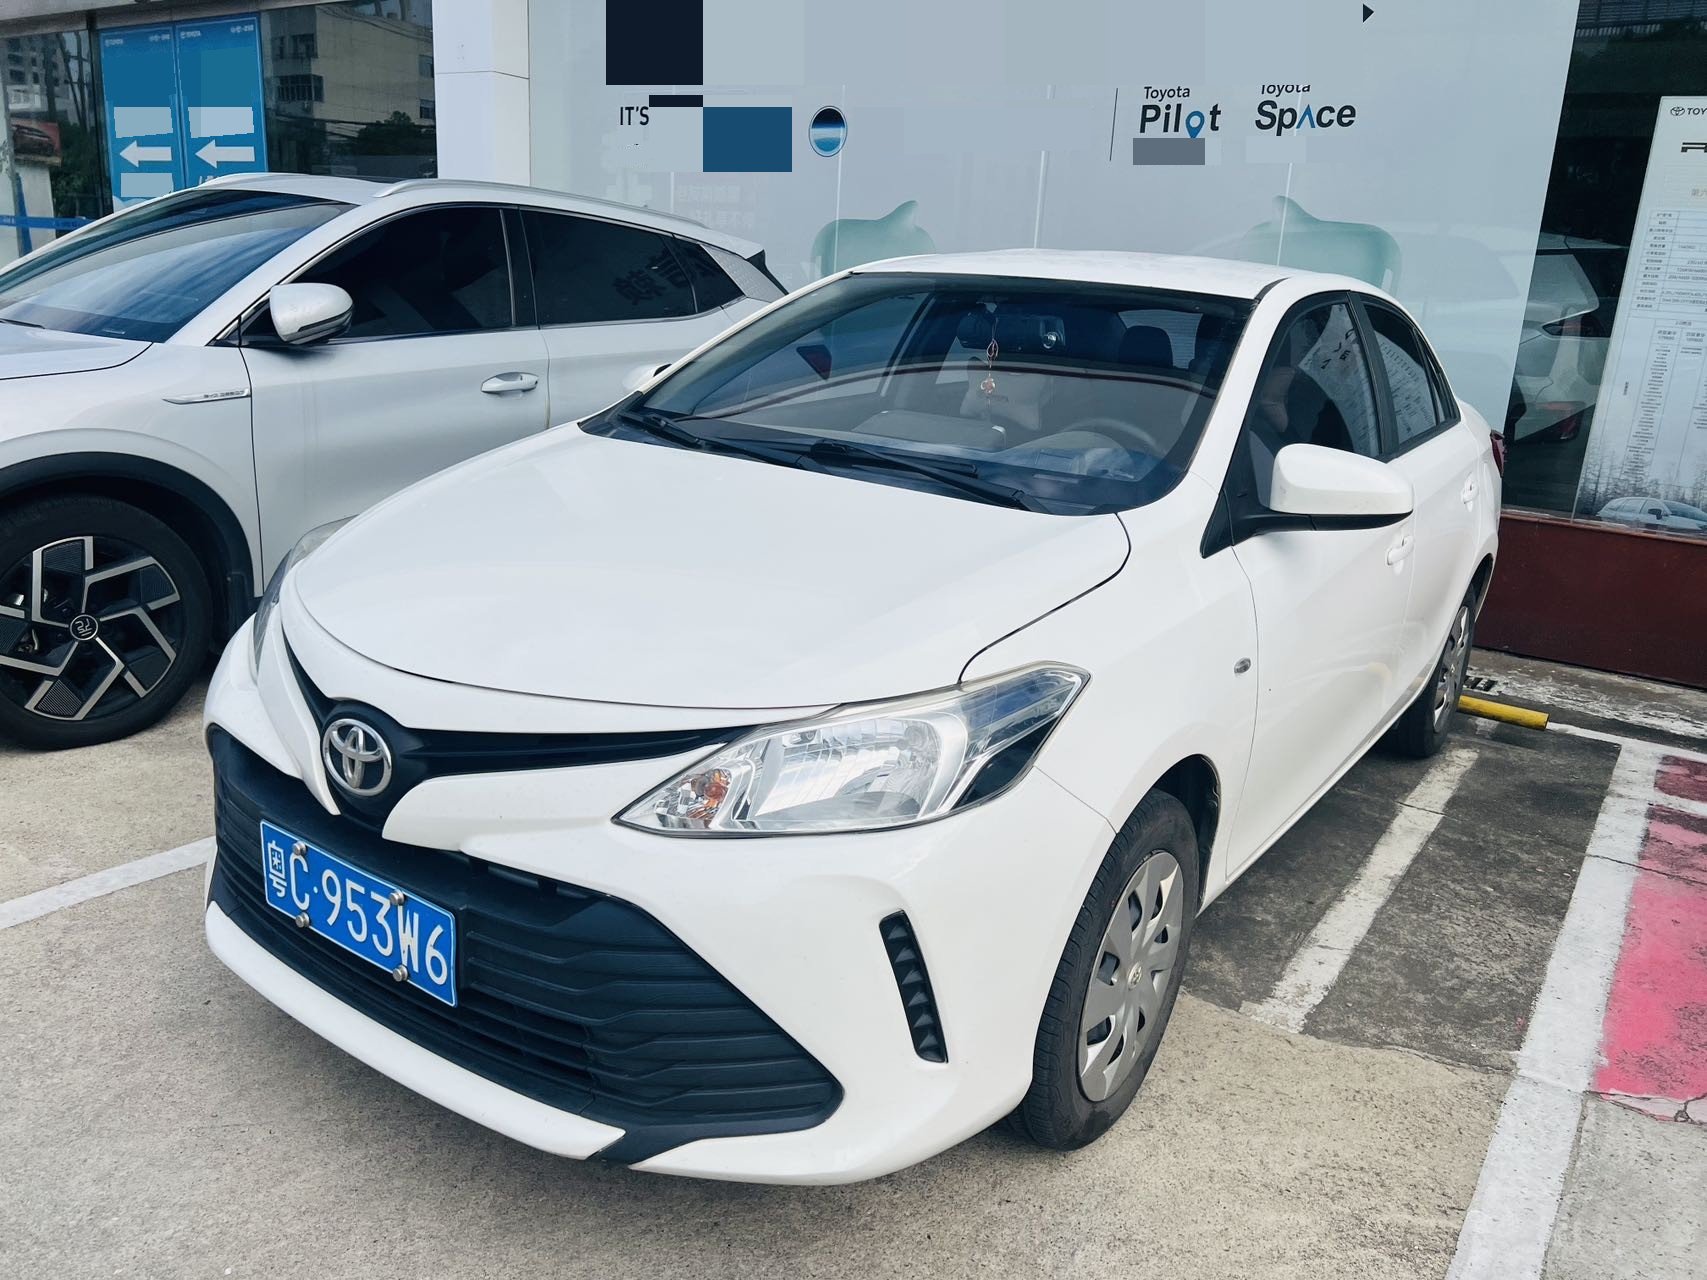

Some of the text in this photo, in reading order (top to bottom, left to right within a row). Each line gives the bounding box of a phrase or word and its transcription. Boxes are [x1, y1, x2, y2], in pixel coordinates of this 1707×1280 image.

[1144, 86, 1191, 102] Toyota
[620, 106, 650, 126] IT'S
[1139, 103, 1222, 139] Pilot
